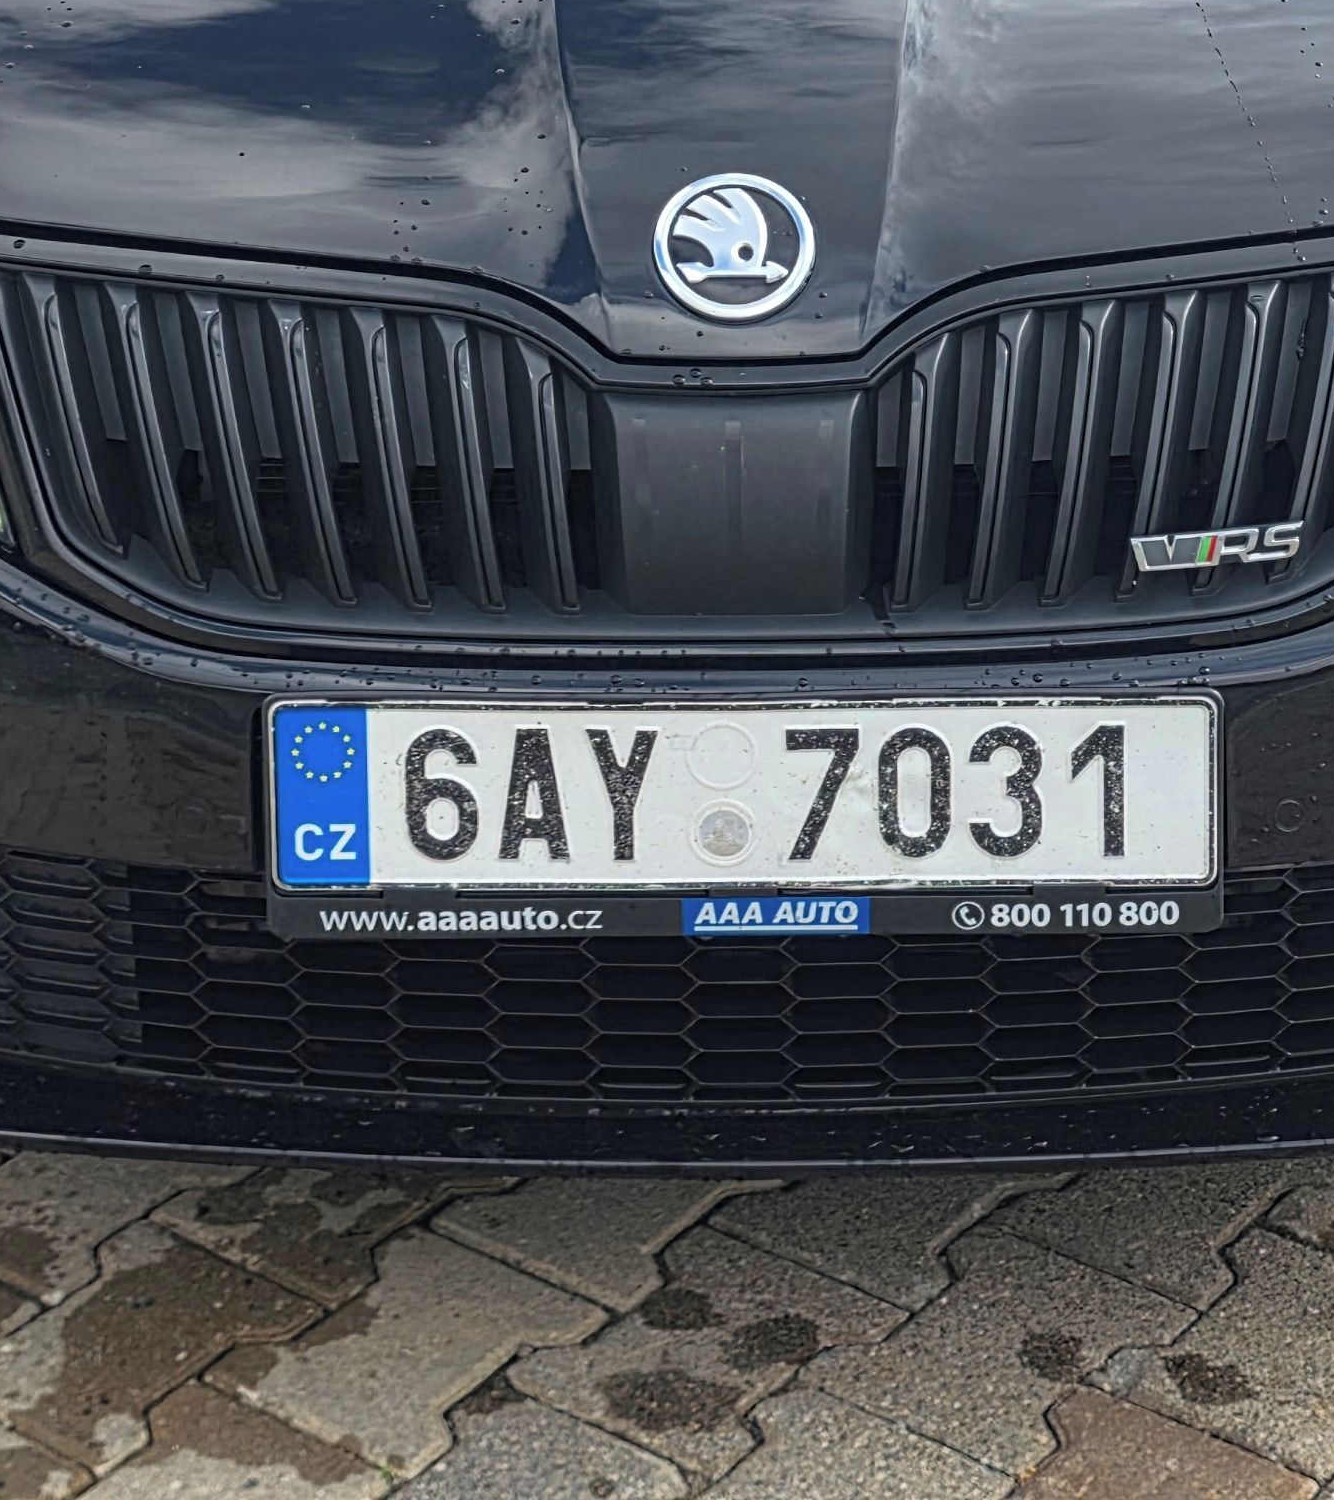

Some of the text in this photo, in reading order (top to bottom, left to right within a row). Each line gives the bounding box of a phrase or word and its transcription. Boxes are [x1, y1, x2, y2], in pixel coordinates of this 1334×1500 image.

[405, 723, 1129, 863] 6AY 7031
[294, 823, 357, 861] CZ
[319, 907, 603, 933] www.aaaauto.cz
[694, 900, 860, 925] AAA AUTO
[990, 900, 1181, 929] 800 110 800
